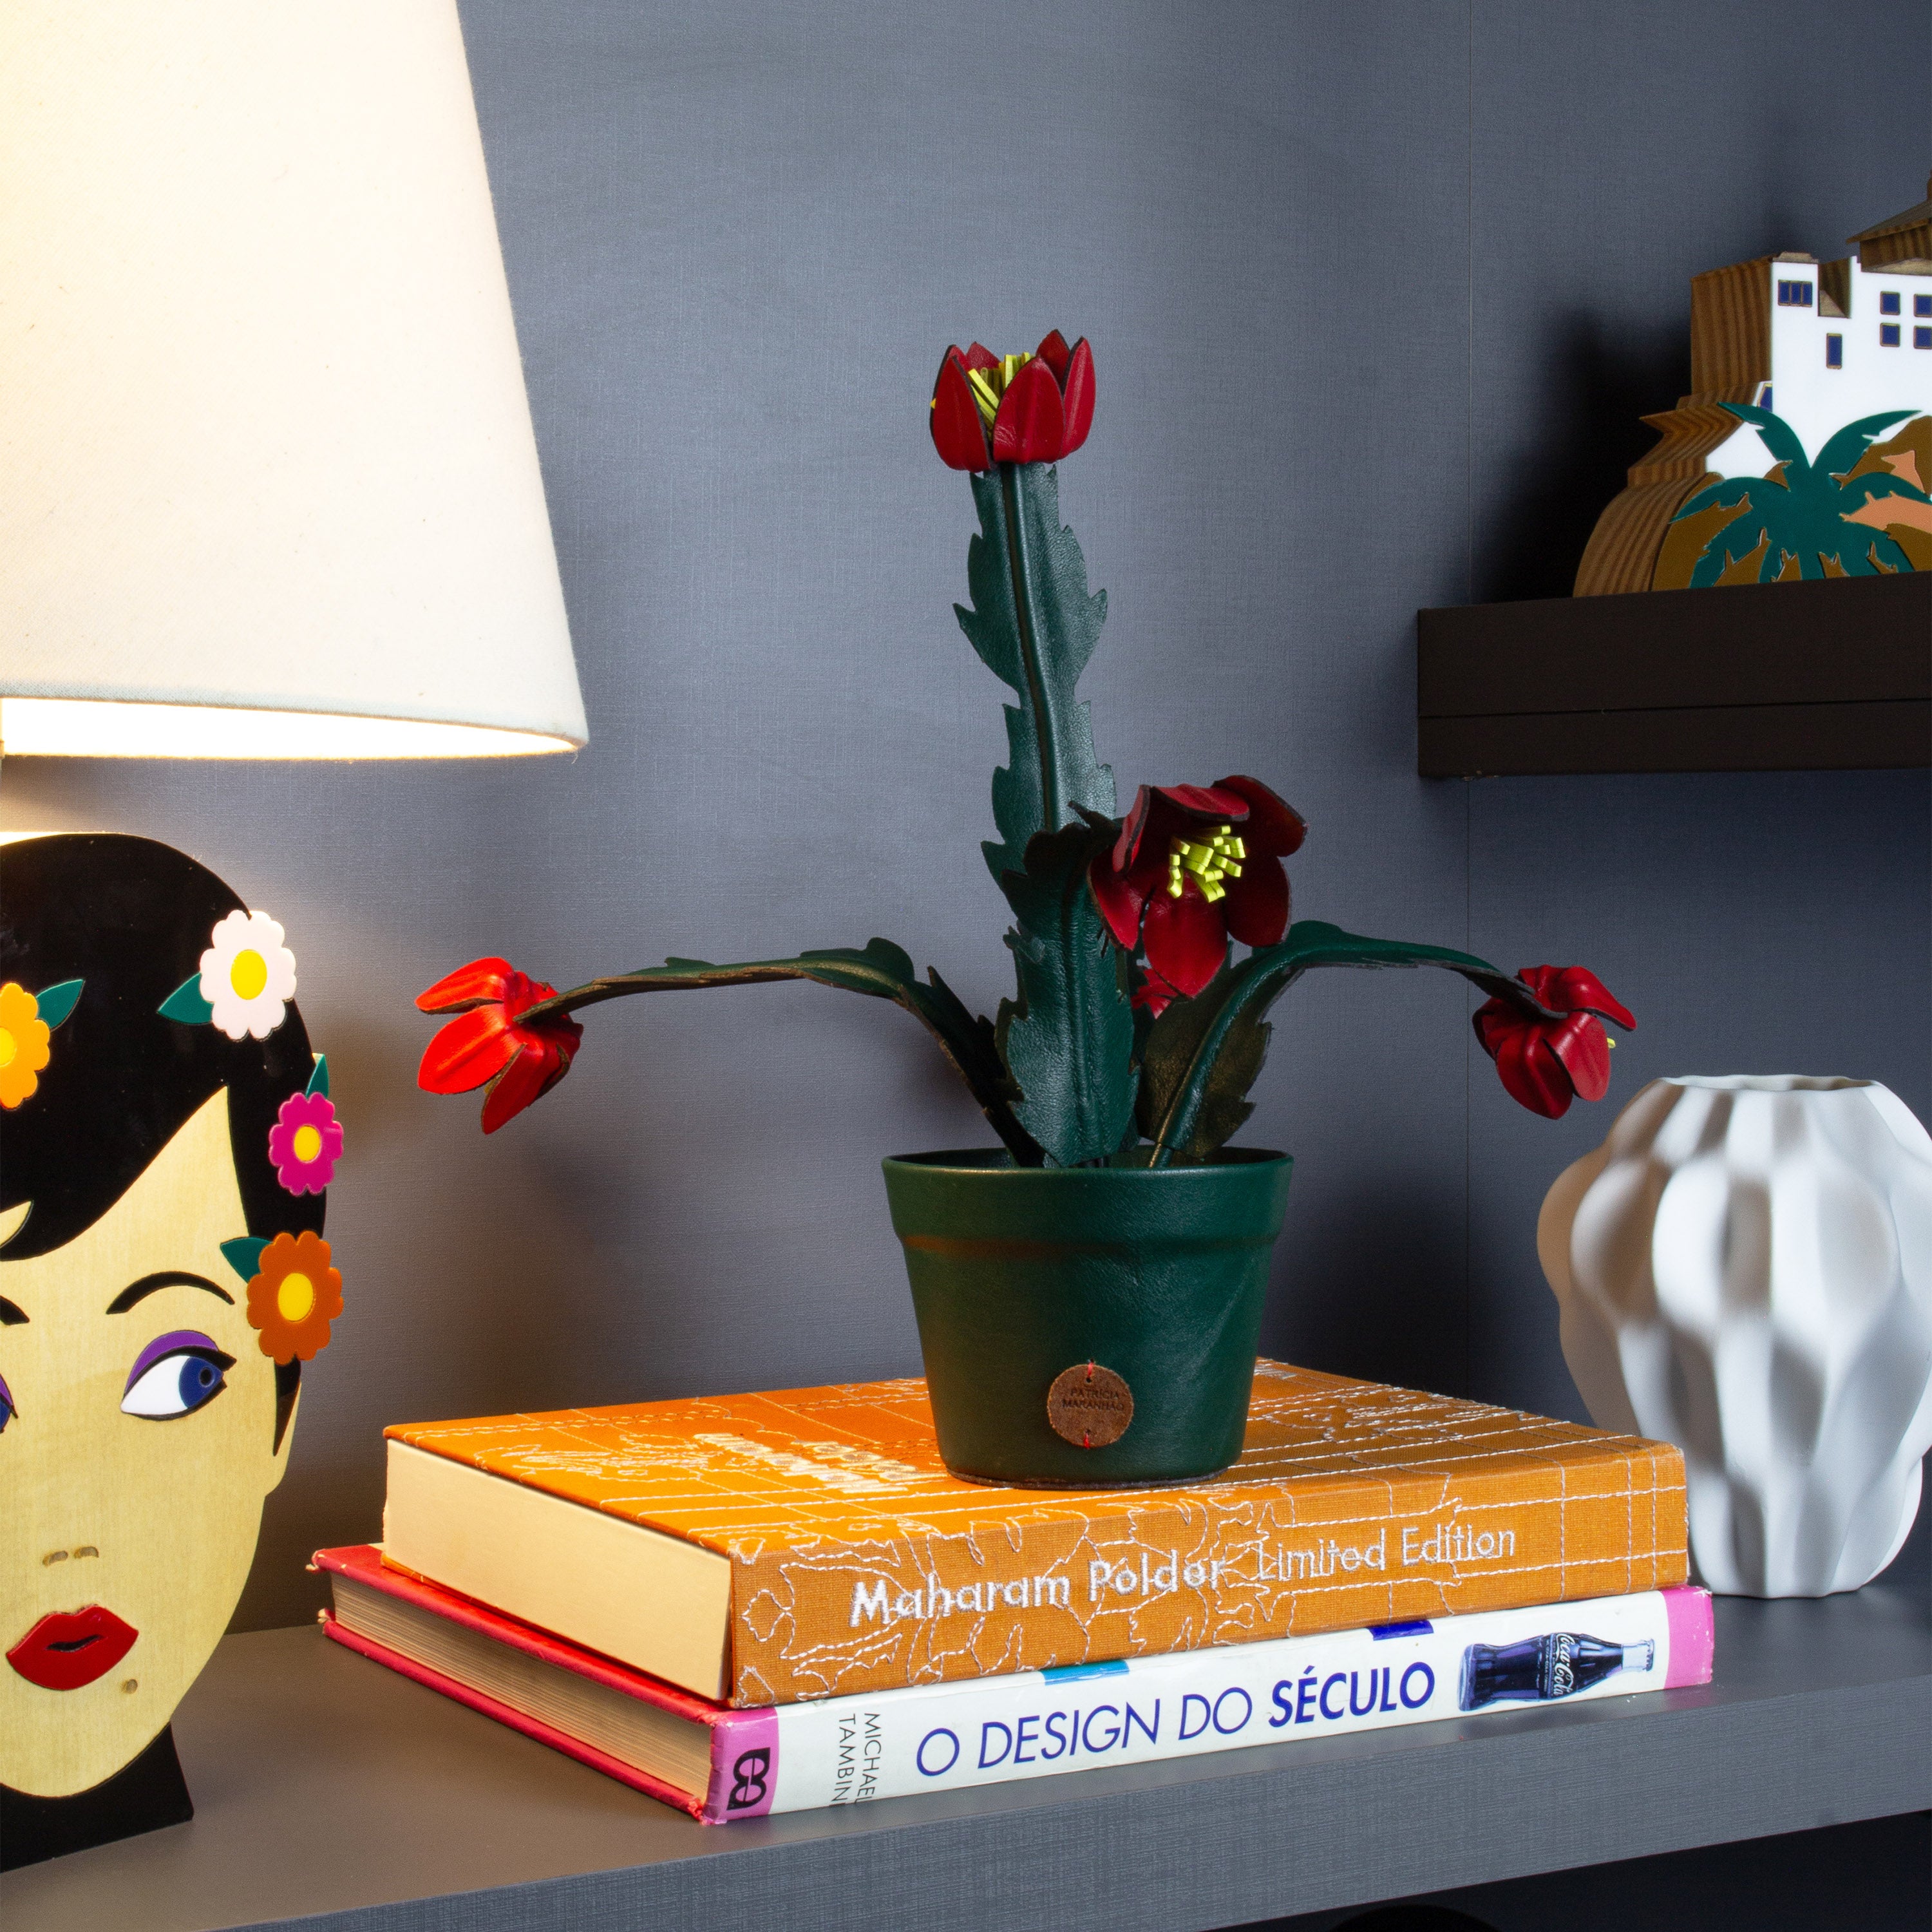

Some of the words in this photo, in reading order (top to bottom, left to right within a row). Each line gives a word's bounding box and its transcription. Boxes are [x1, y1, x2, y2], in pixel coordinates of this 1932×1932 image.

[849, 1572, 1070, 1627] Maharam
[1089, 1549, 1226, 1602] Polder
[1258, 1528, 1385, 1581] Limited
[1402, 1523, 1515, 1567] Edition
[916, 1728, 960, 1777] O
[978, 1699, 1160, 1769] DESIGN
[1178, 1687, 1253, 1740] DO
[1268, 1662, 1435, 1728] SÉCULO
